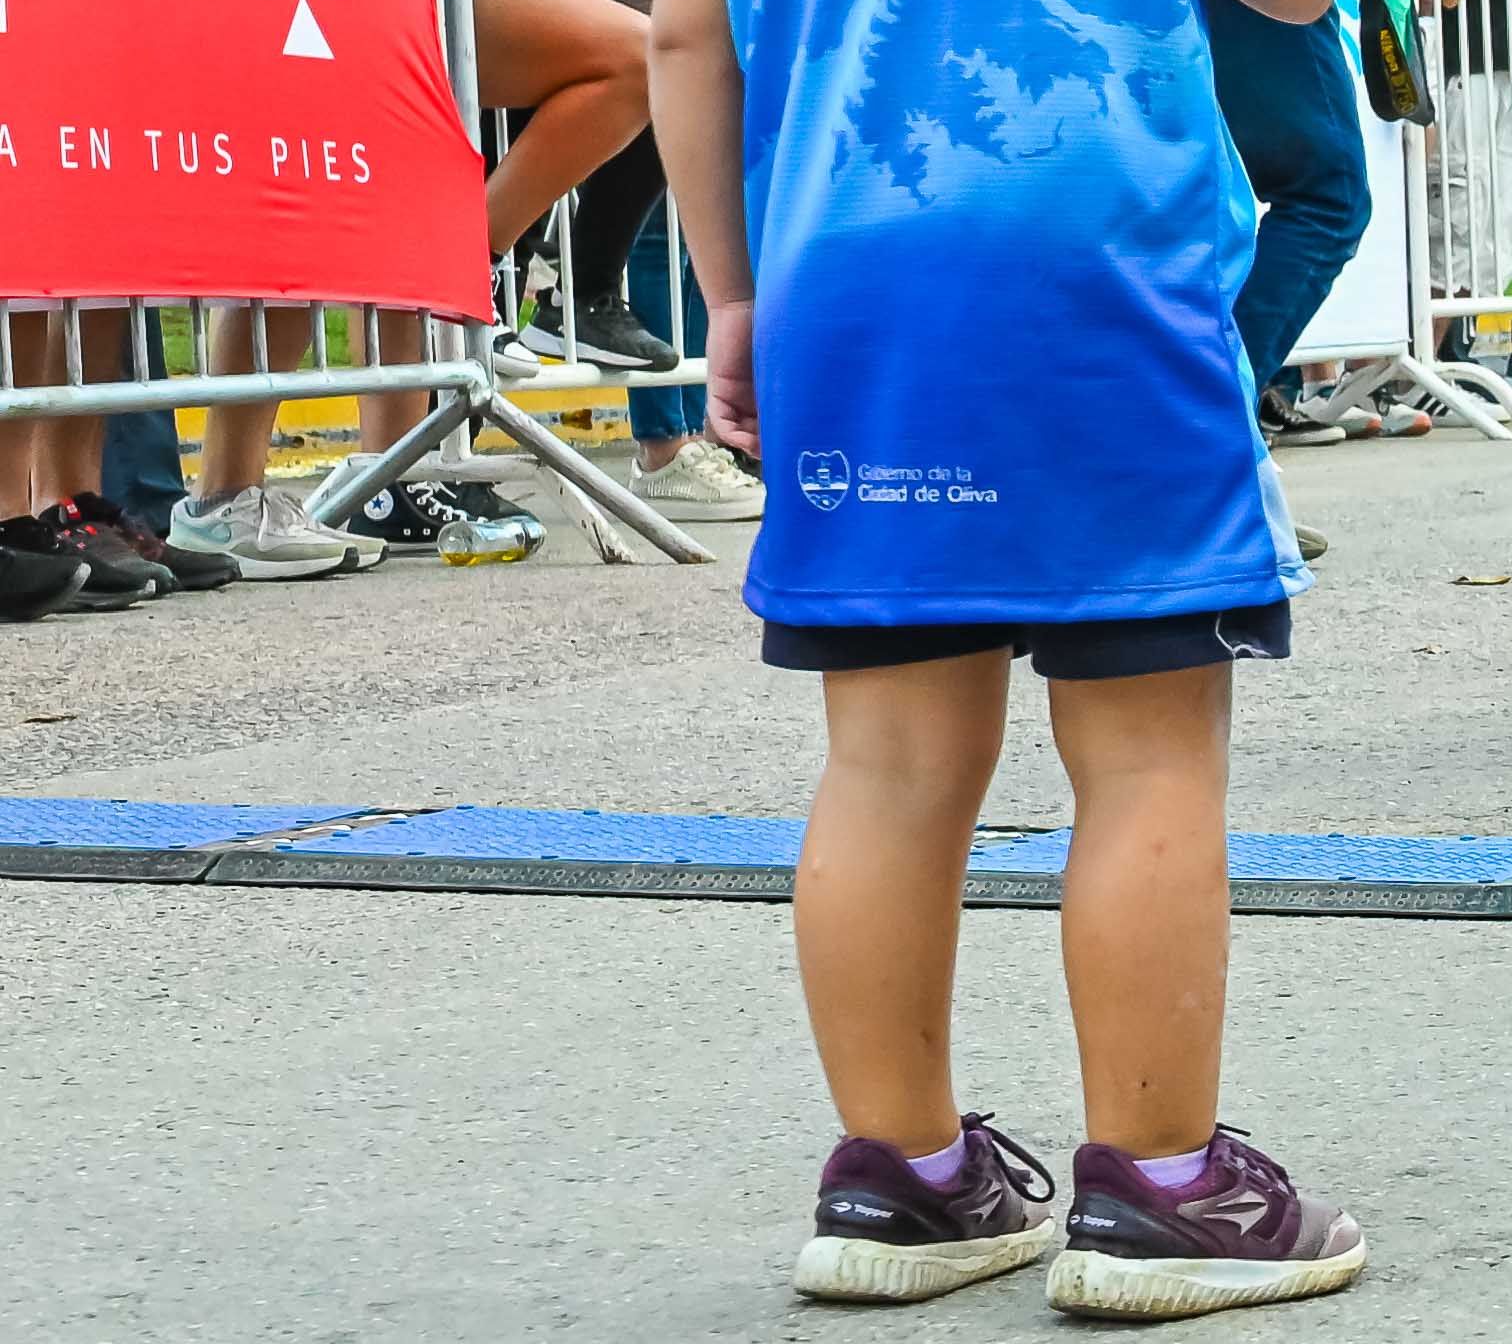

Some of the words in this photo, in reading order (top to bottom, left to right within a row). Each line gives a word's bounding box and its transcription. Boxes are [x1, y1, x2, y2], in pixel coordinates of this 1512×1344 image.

[1381, 29, 1399, 72] Nikon
[60, 126, 111, 170] EN
[144, 129, 233, 175] TUS
[271, 137, 370, 184] PIES
[914, 485, 940, 503] de
